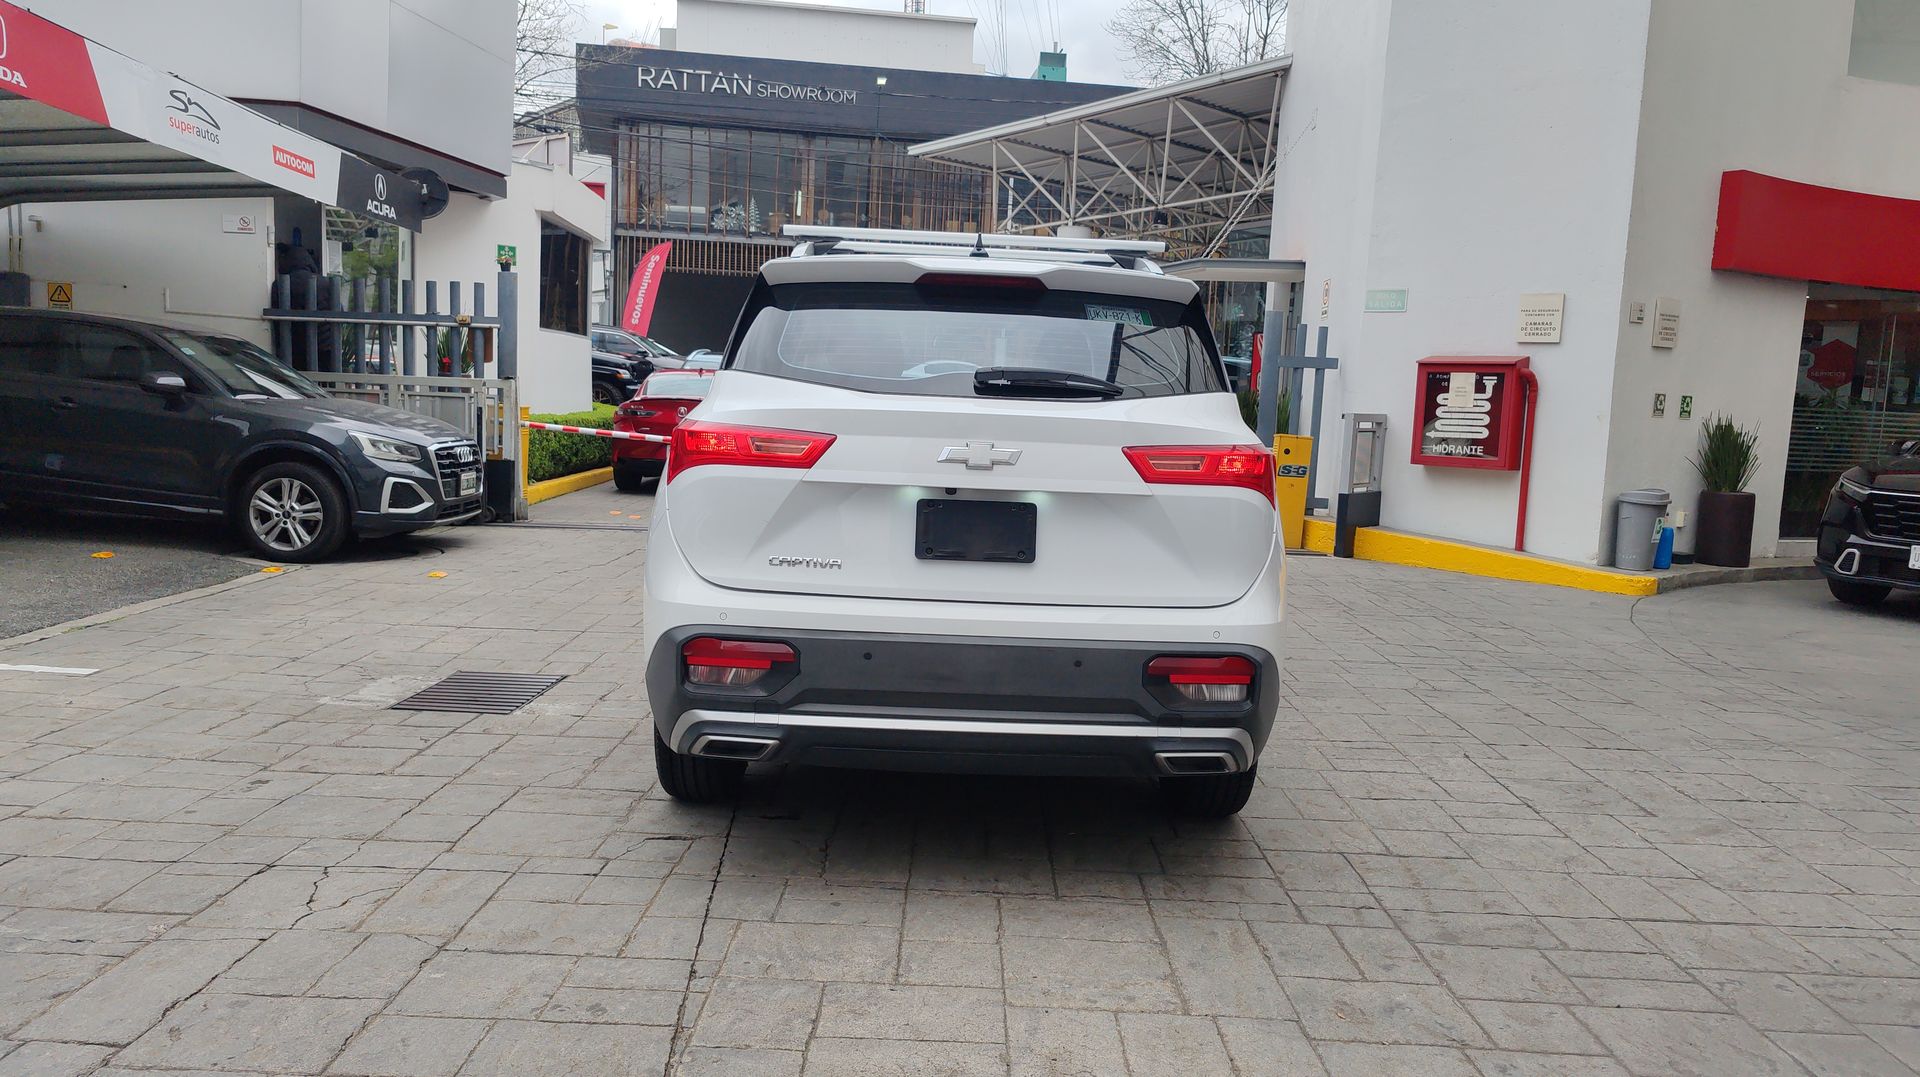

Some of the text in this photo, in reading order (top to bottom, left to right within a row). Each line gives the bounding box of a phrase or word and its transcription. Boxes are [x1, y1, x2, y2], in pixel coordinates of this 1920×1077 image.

[638, 67, 857, 105] RATTAN SHOWROOM
[169, 116, 220, 145] superautos
[275, 150, 313, 175] AUTOCOM
[366, 198, 397, 220] ACURA
[631, 255, 661, 325] Seminuevos
[1432, 444, 1485, 455] HIDRANTE
[769, 555, 842, 569] CAPTIVA
